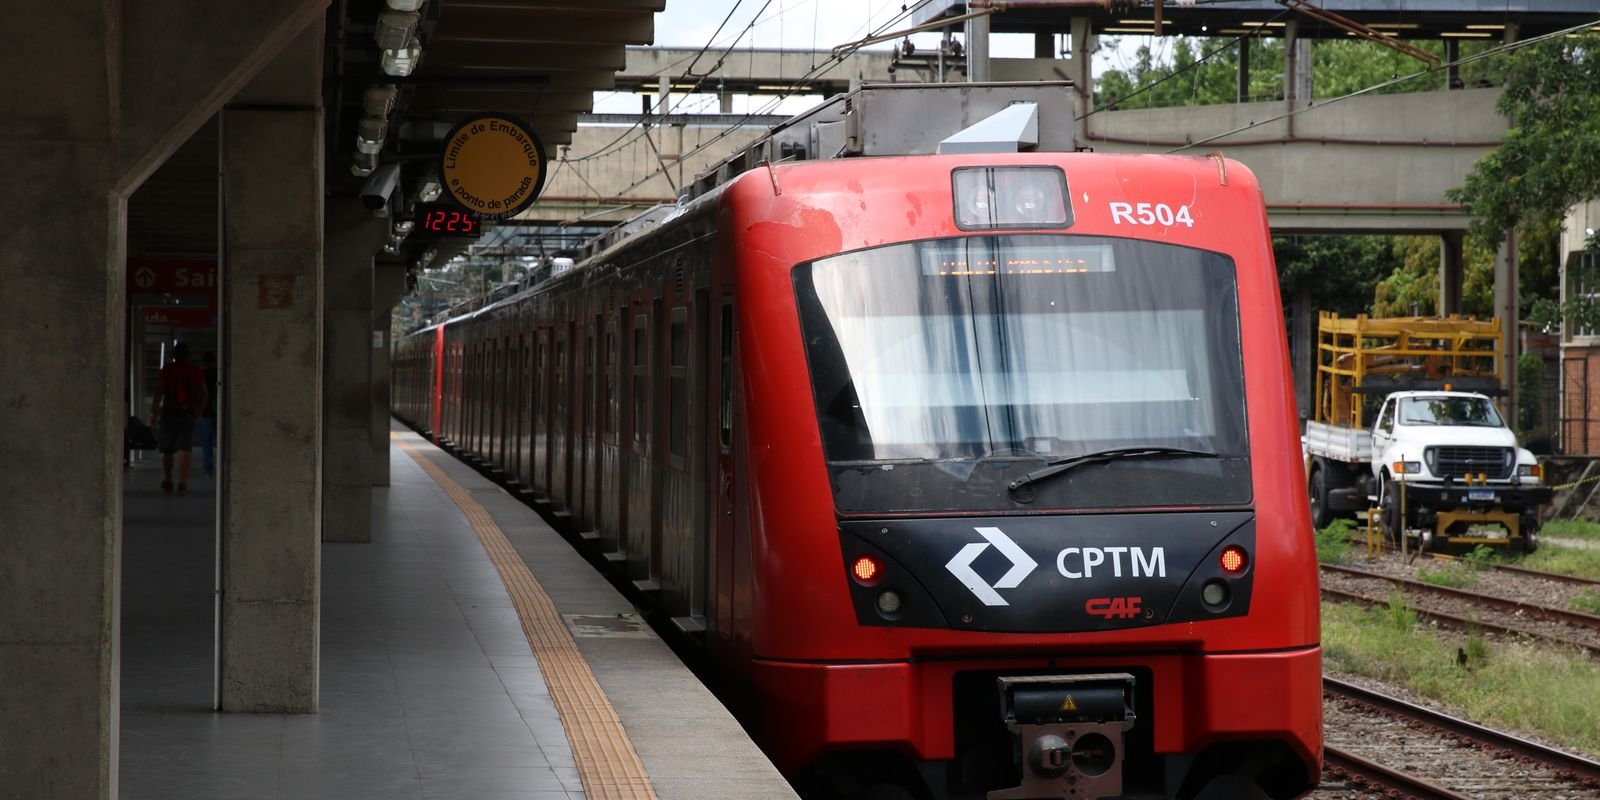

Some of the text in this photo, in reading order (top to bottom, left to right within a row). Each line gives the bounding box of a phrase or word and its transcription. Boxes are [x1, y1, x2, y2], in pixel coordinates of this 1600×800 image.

[446, 121, 537, 169] Limite de Embarque
[454, 187, 485, 208] ponto
[487, 200, 500, 209] de
[503, 176, 532, 208] parada
[1109, 202, 1194, 228] R504
[176, 267, 219, 287] Saí
[1056, 547, 1167, 579] CPTM
[1085, 597, 1142, 620] CAF
